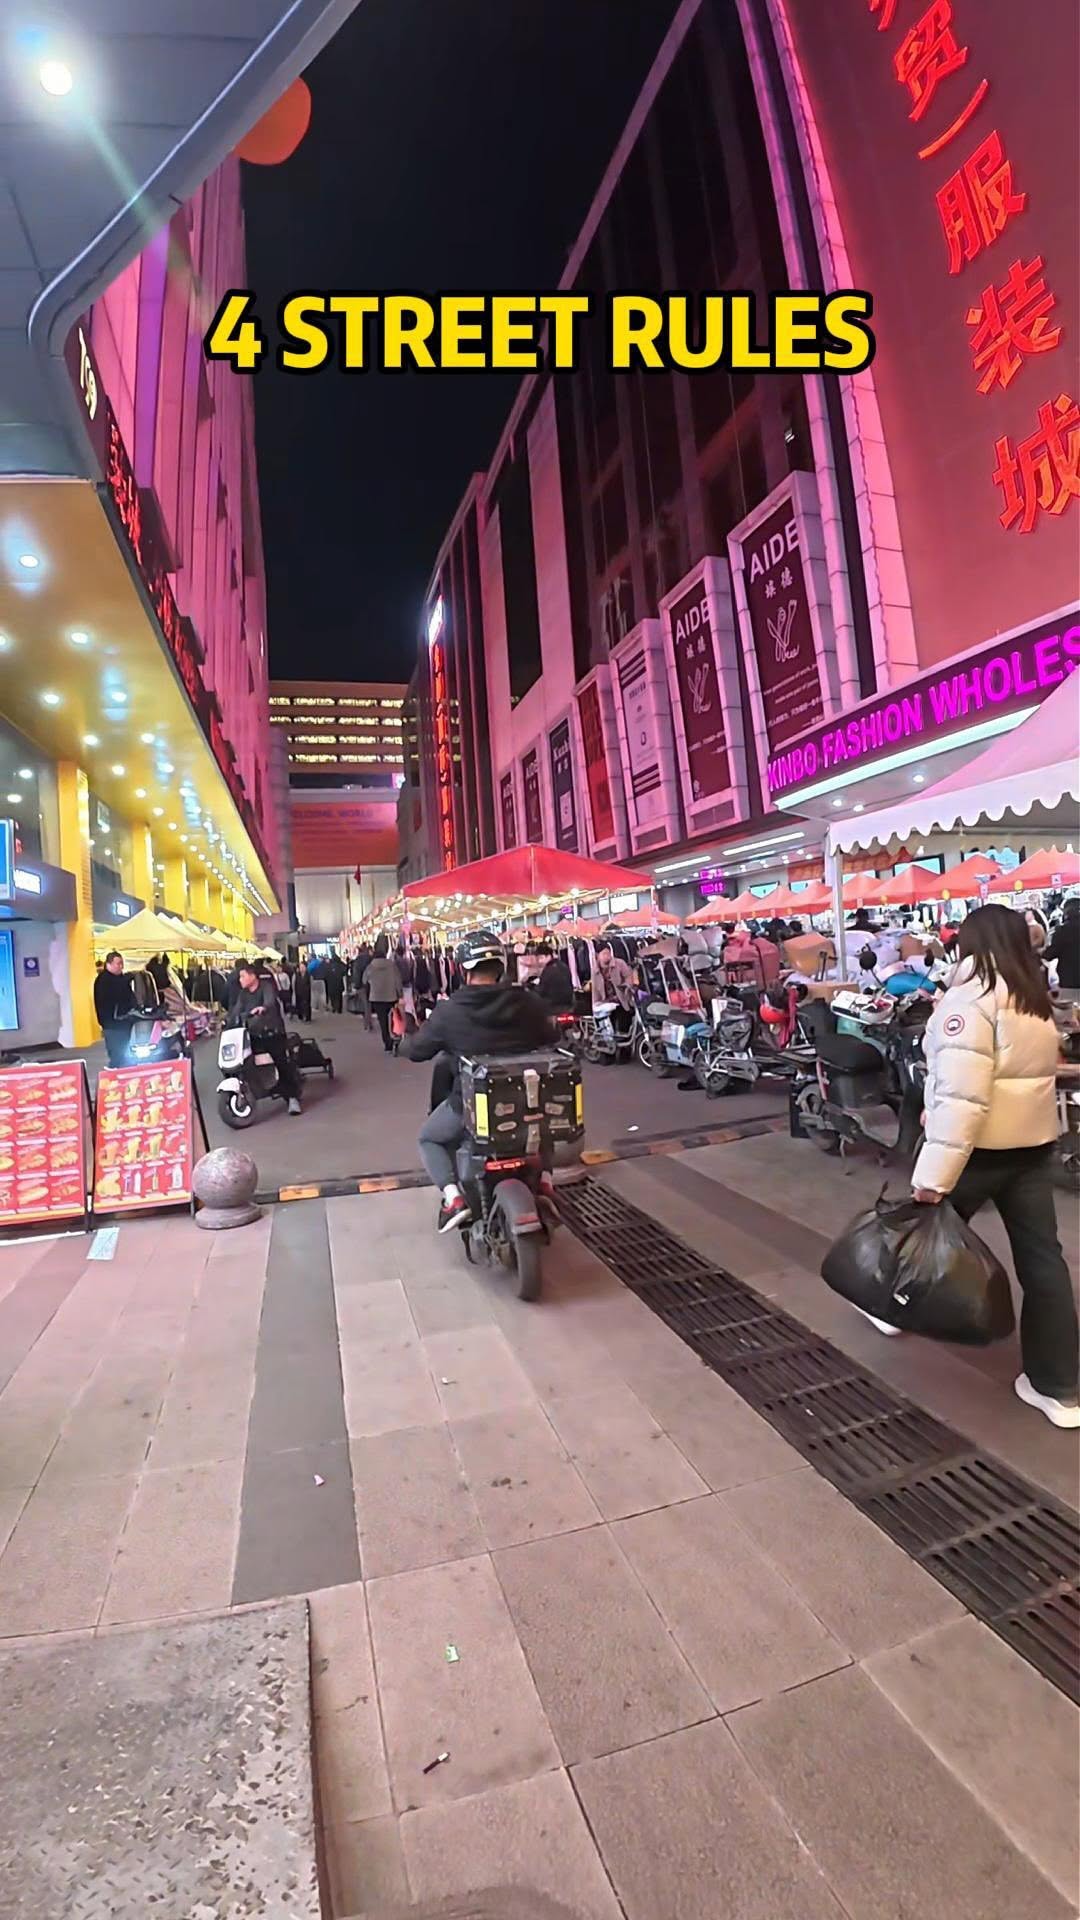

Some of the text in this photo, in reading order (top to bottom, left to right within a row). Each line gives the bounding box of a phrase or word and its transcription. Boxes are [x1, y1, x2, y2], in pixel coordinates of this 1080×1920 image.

[868, 0, 1080, 534] 贸一服装城
[750, 517, 799, 584] AIDE
[676, 597, 709, 645] AIDE
[767, 742, 817, 792] KINBO
[822, 692, 923, 769] FASHION
[929, 625, 1080, 725] WHOLES
